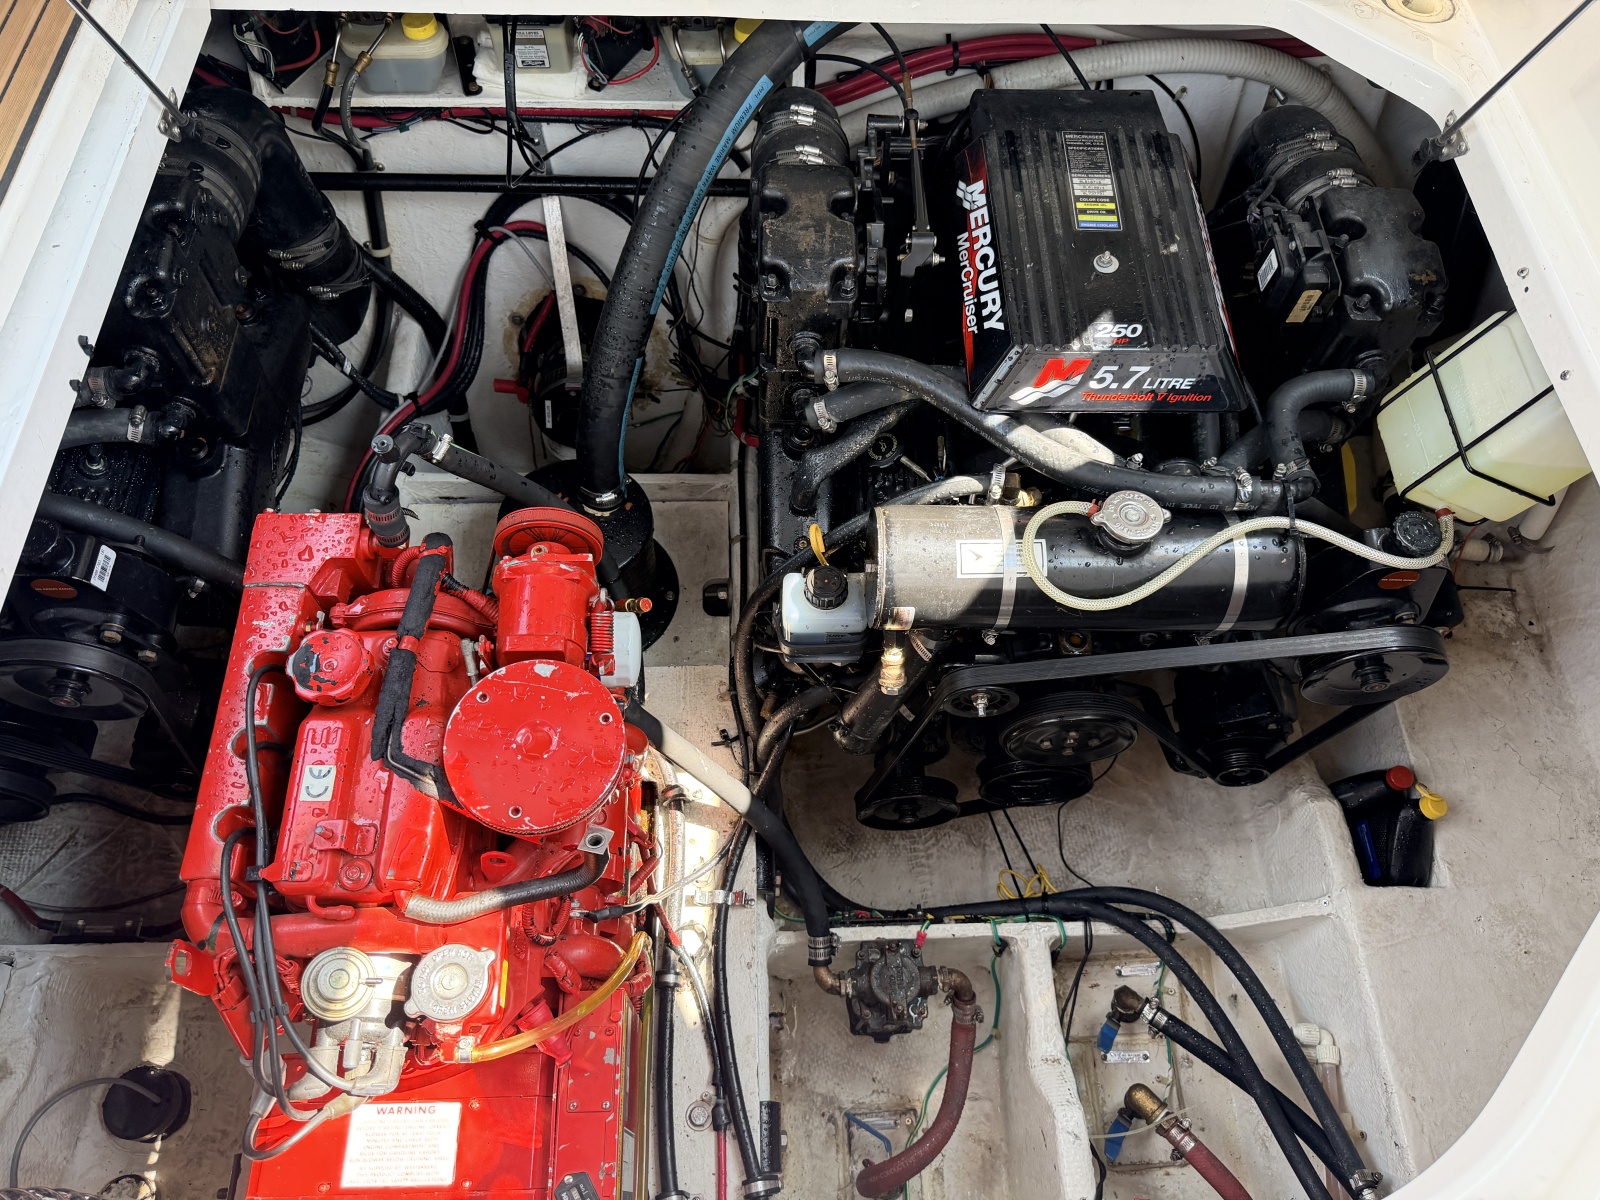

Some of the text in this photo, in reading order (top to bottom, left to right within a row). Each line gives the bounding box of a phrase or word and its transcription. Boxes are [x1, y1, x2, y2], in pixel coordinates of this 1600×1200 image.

[731, 104, 752, 134] PREMIUM
[715, 136, 730, 163] MARINE
[702, 164, 716, 187] WATER
[687, 188, 703, 219] EXHAUST
[966, 180, 1004, 330] MERCURY
[957, 231, 978, 334] MerCruiser
[1095, 324, 1142, 338] 250
[1090, 366, 1196, 389] 5.7 LITRE
[1082, 392, 1212, 403] Thunderbolt V Ignition
[377, 1106, 436, 1115] WARNING
